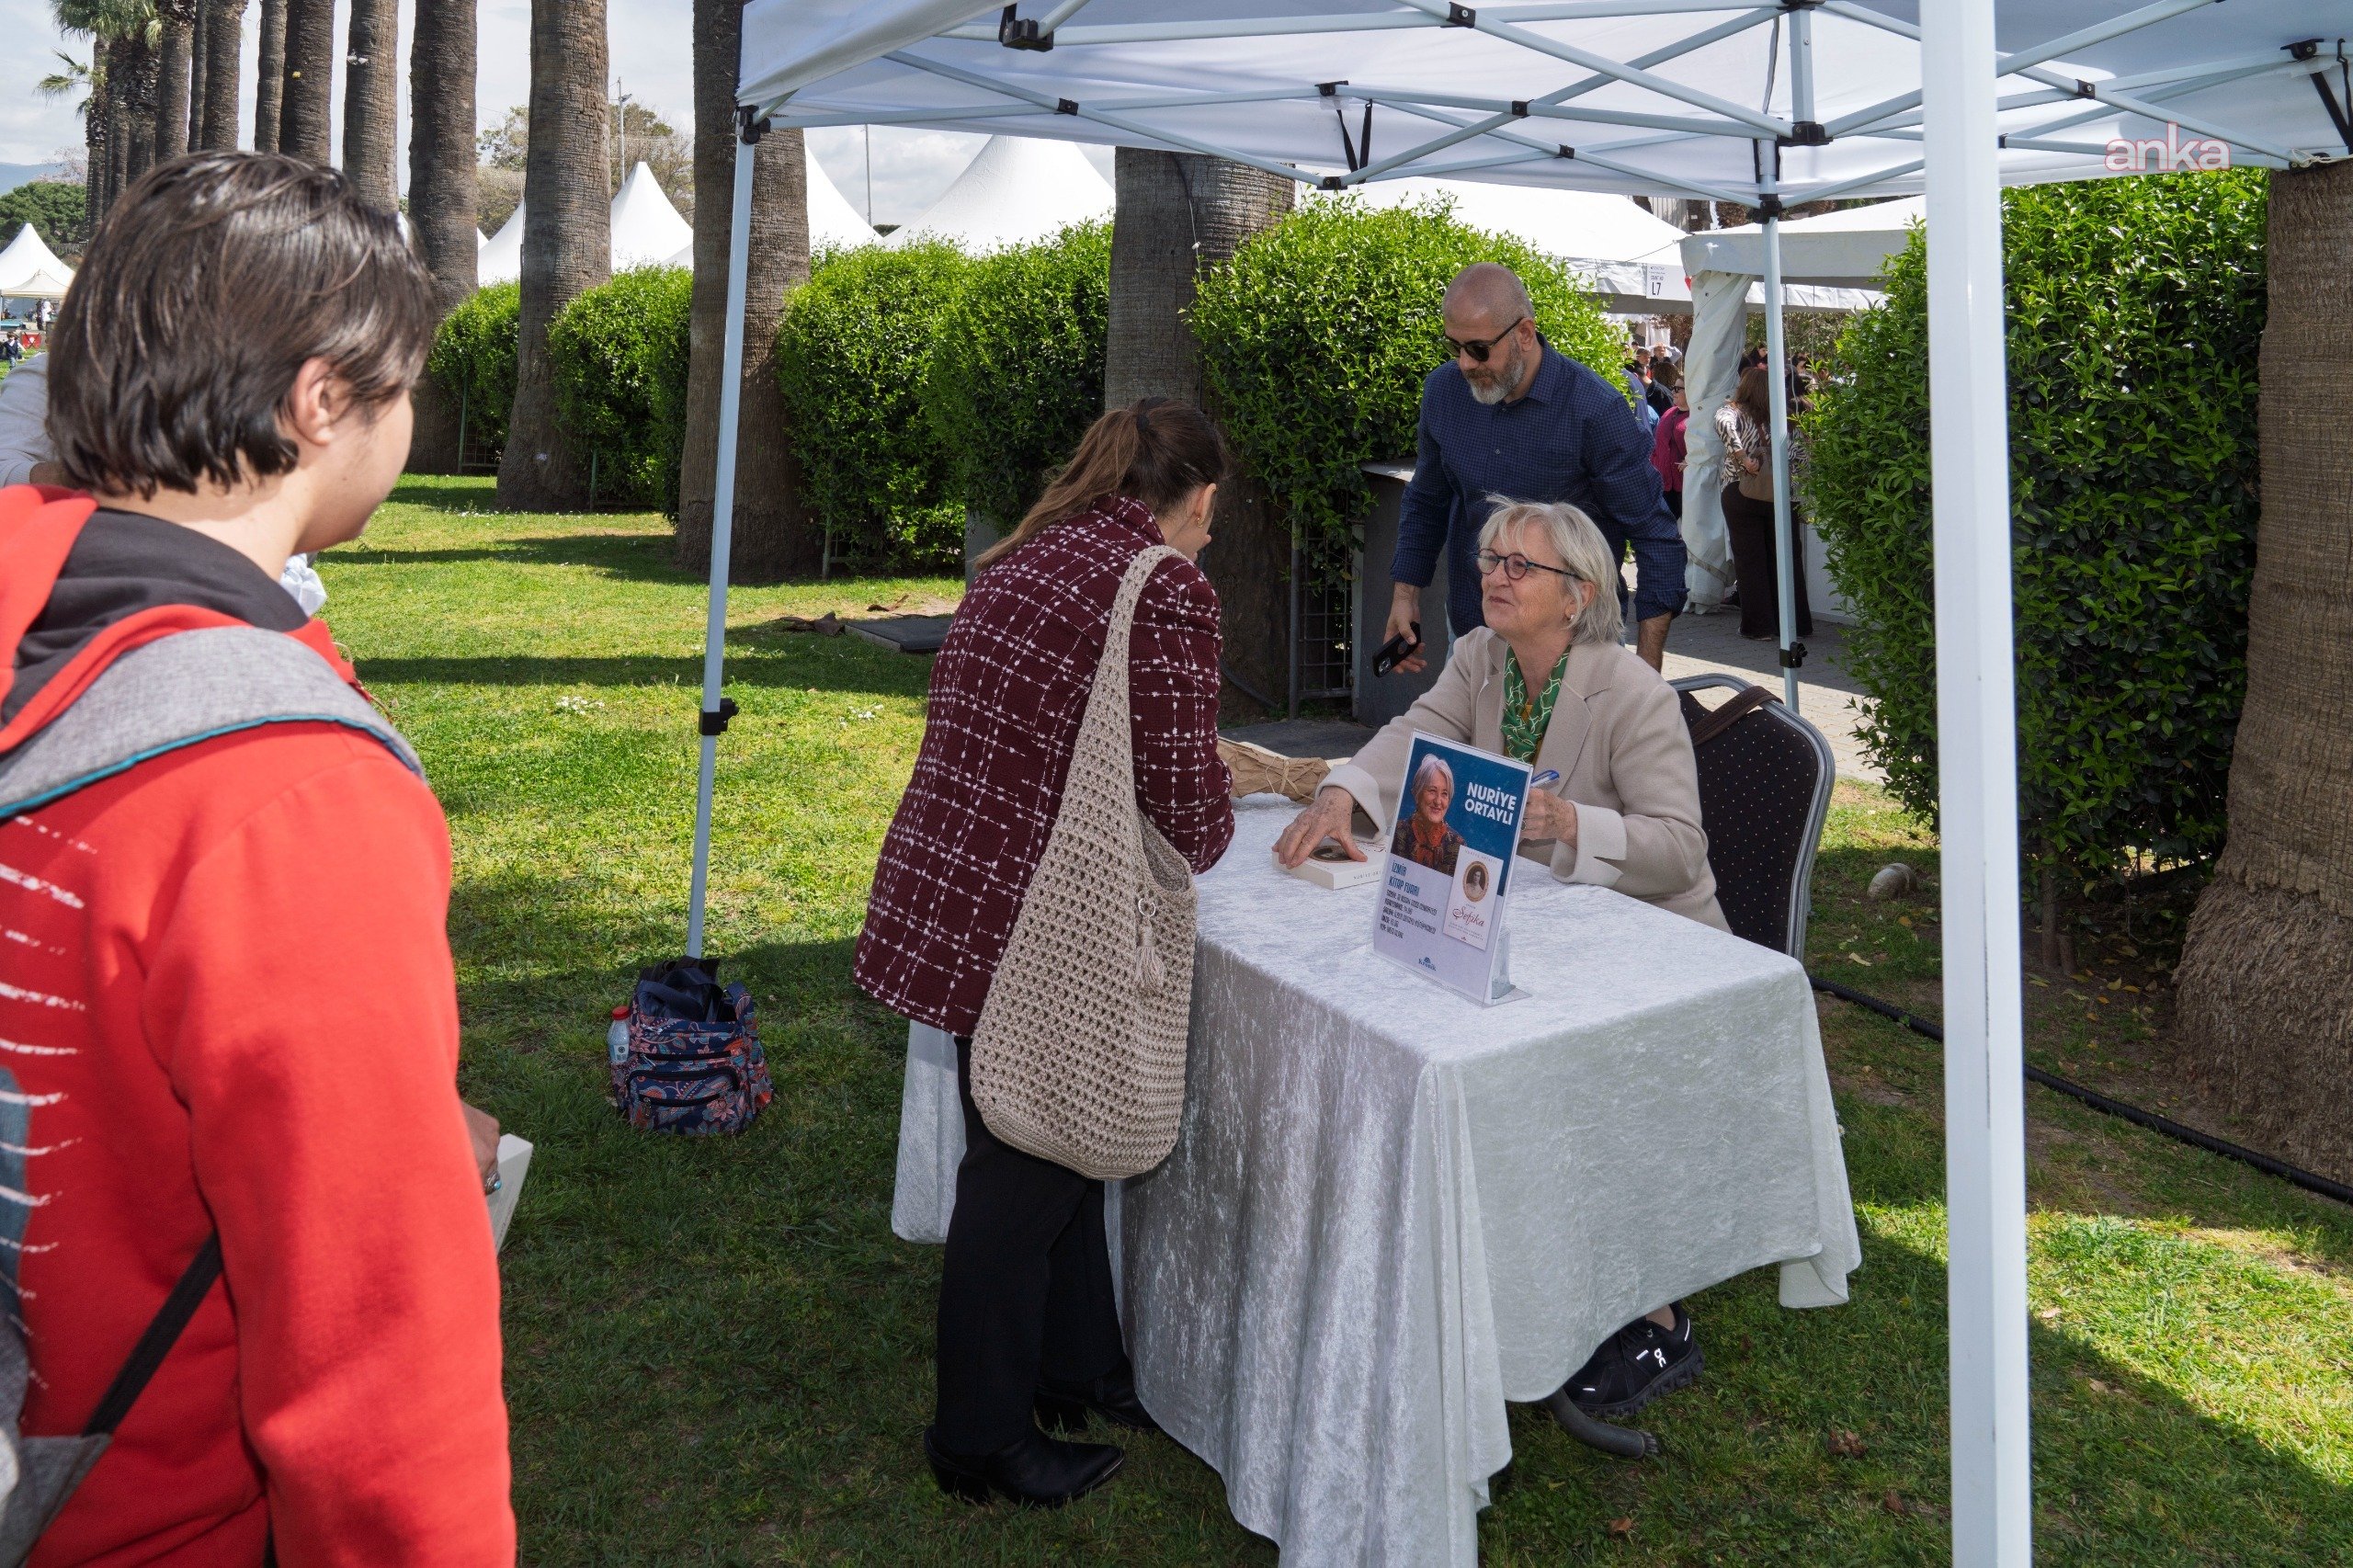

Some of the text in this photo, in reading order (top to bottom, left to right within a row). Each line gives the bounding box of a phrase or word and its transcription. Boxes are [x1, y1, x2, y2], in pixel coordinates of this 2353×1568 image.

[1652, 281, 1662, 295] L7
[1467, 781, 1517, 811] NURİYE
[1464, 798, 1514, 825] ORTAYLI
[1388, 875, 1420, 897] KİTAP FUARI
